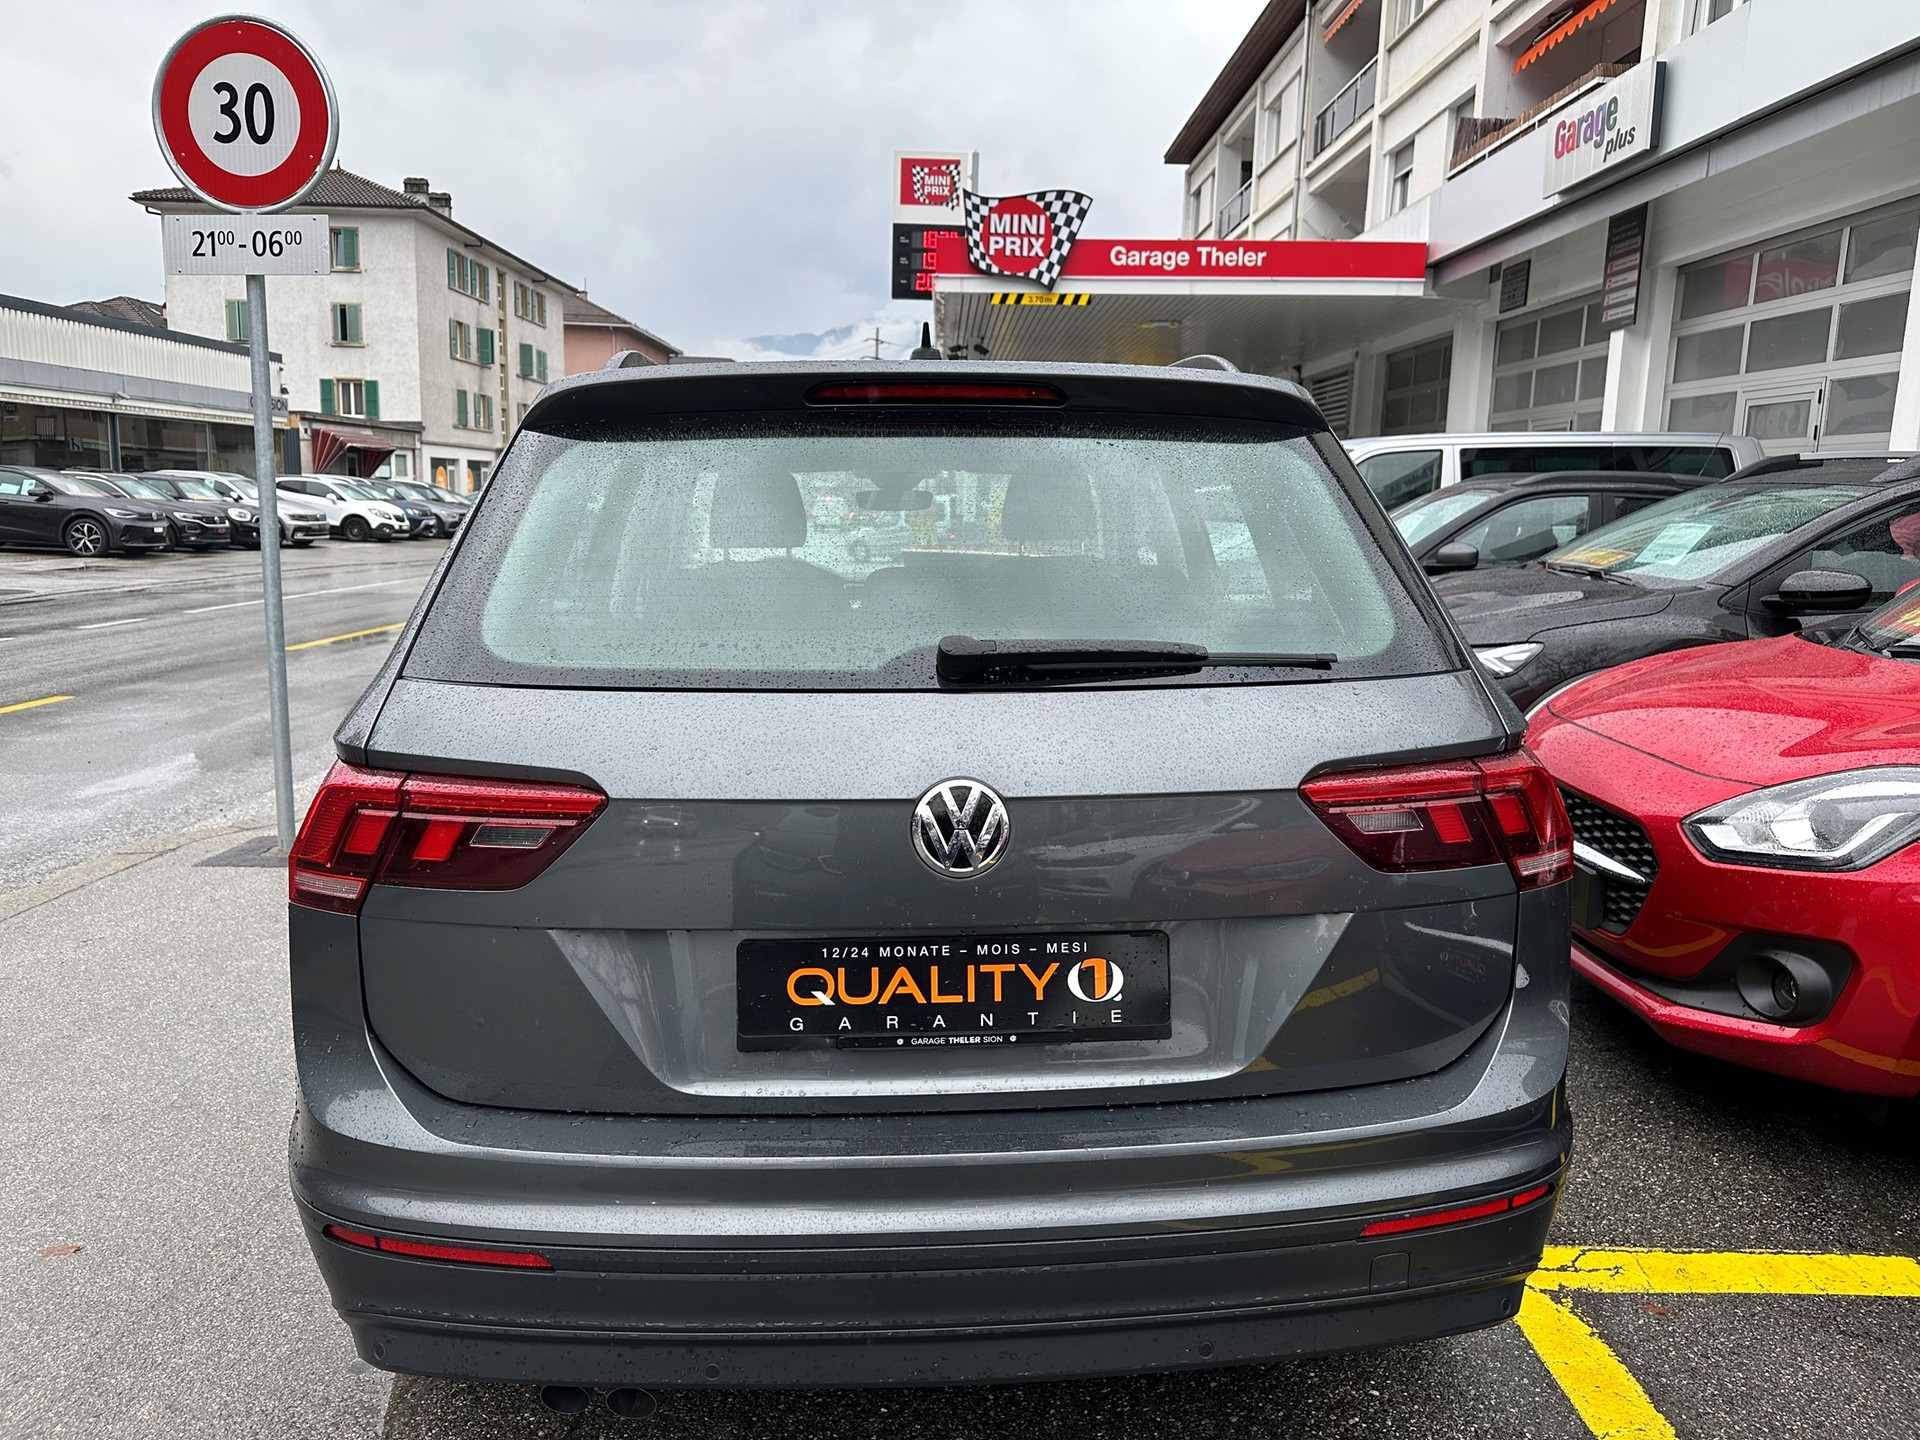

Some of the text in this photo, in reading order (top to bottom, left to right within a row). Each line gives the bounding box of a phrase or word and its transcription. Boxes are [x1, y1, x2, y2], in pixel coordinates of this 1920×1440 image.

[212, 81, 275, 145] 30
[1554, 96, 1618, 159] Garage
[1603, 126, 1636, 163] plus
[923, 175, 950, 186] MINI
[923, 185, 951, 196] PRIX
[989, 212, 1045, 235] MINI
[988, 236, 1045, 257] PRIX
[1109, 245, 1267, 270] Garage Theler
[821, 947, 869, 958] 12/24
[879, 945, 951, 958] MONATE
[976, 943, 1021, 956] MOIS
[1046, 941, 1088, 954] MESI
[786, 962, 1061, 1006] QUALITY
[911, 1035, 1003, 1046] GARAGE THELER SION
